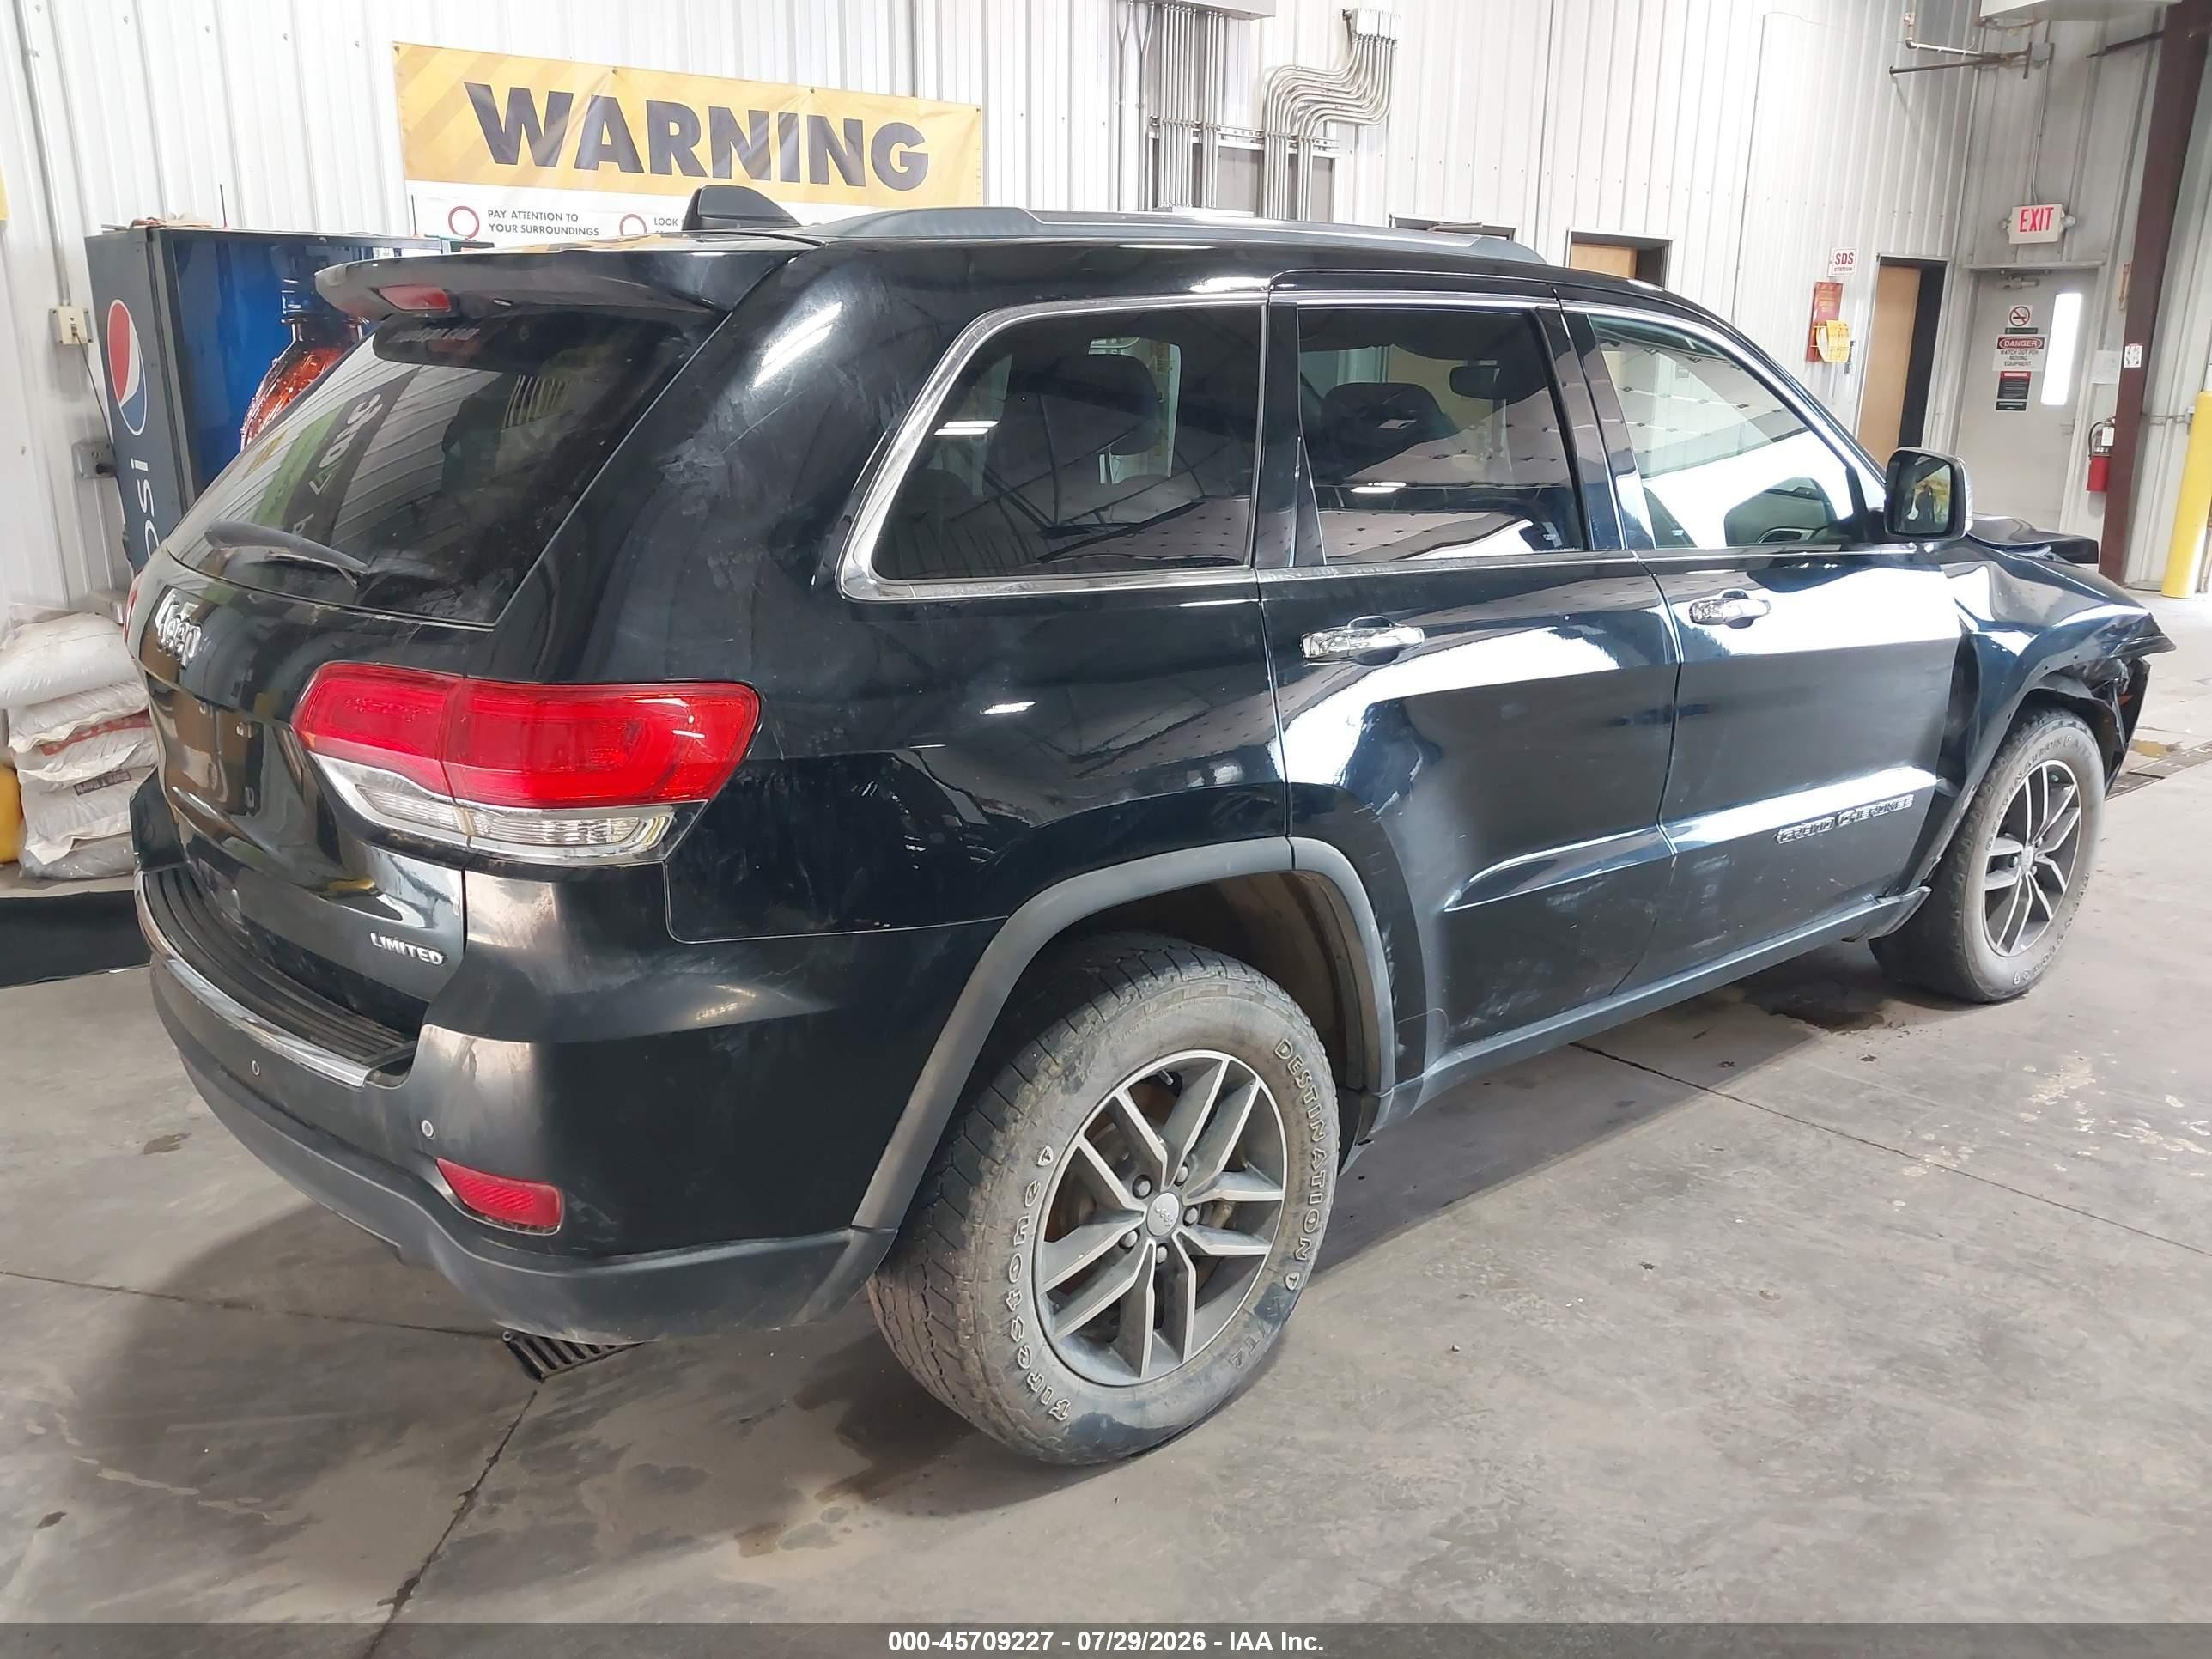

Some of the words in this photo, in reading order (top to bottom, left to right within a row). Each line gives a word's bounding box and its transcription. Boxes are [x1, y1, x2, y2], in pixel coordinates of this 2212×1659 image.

[463, 81, 929, 191] WARNING
[487, 210, 507, 220] PAY
[511, 210, 563, 222] ATTENTION
[566, 213, 579, 222] TO
[489, 223, 518, 234] YOUR
[520, 224, 599, 236] SURROUNDINGS
[653, 217, 679, 227] LOOK
[2019, 206, 2054, 233] EXIT
[1834, 252, 1855, 266] SDS
[155, 588, 202, 668] Jeep
[1776, 817, 1835, 844] GRAND
[1836, 794, 1915, 829] CHEROKEE
[370, 933, 444, 965] LIMITED
[1273, 1038, 1328, 1261] DESTINATION
[1006, 1181, 1071, 1422] Firestone
